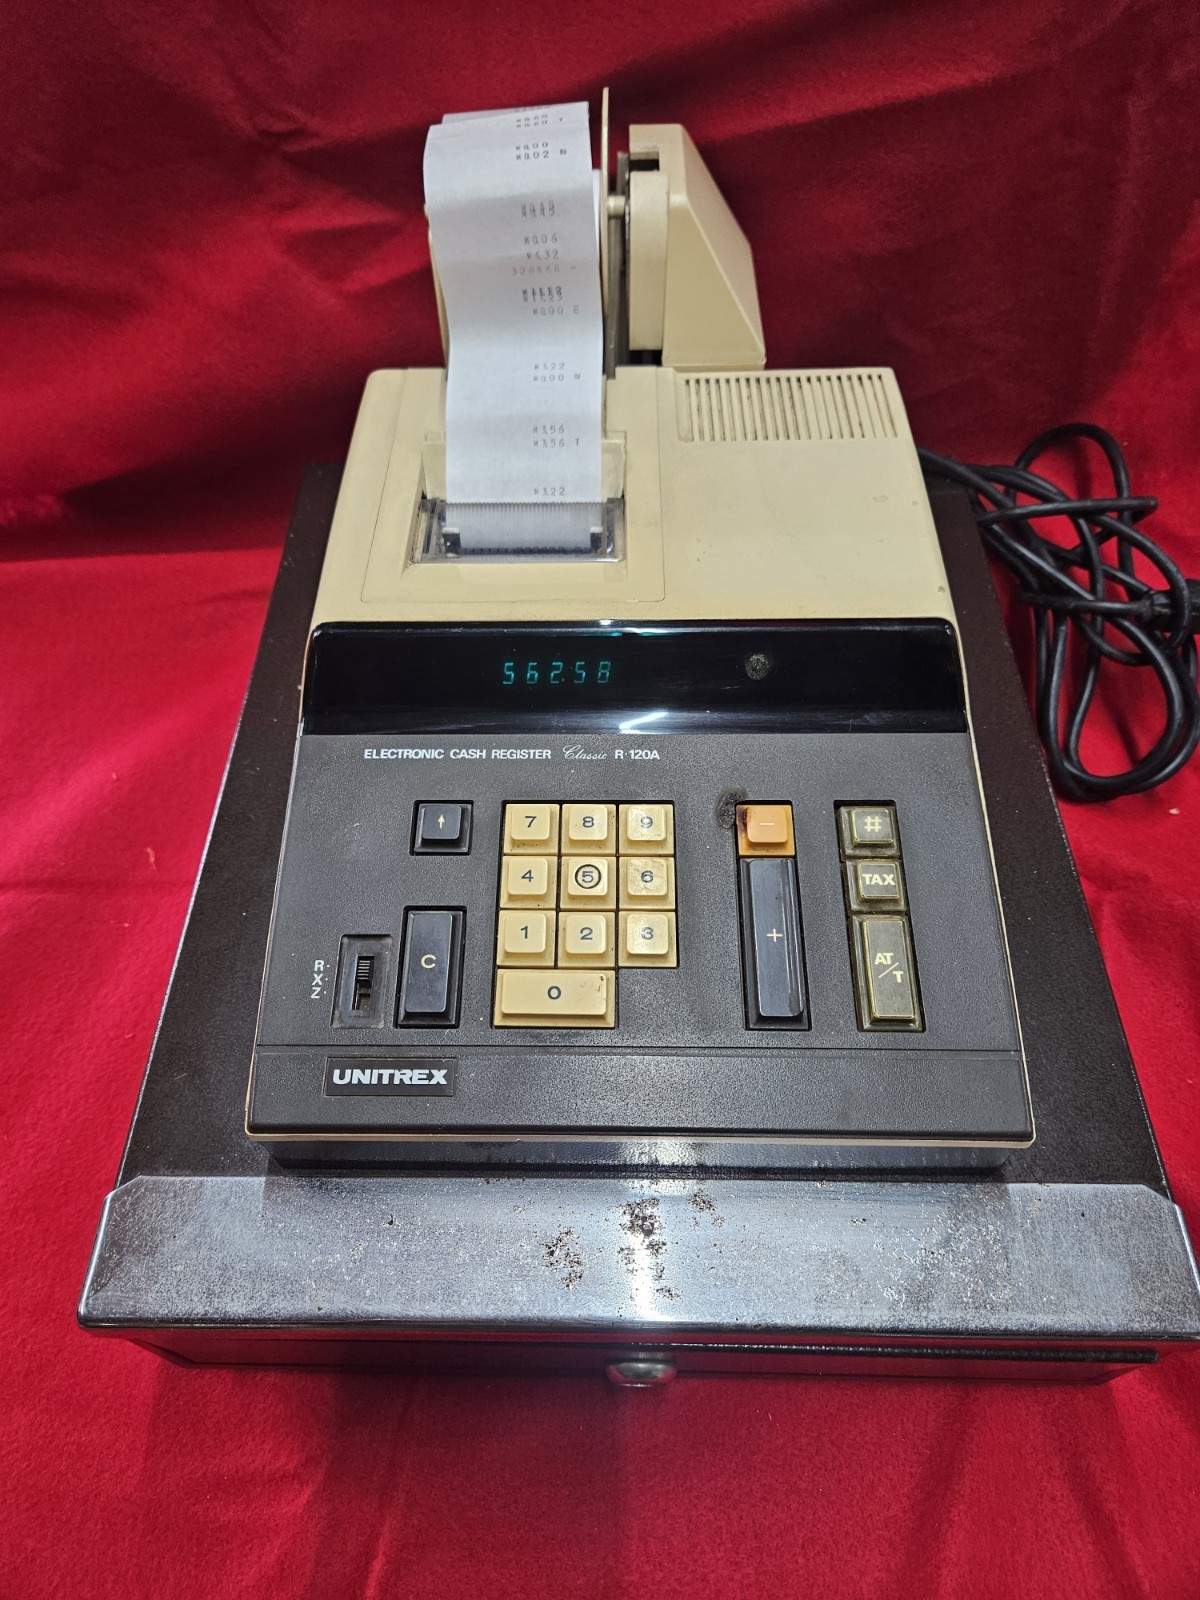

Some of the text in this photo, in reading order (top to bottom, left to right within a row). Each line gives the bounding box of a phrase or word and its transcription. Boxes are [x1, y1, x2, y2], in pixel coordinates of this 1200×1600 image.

[363, 748, 445, 760] ELECTRONIC
[449, 748, 487, 760] CASH
[491, 748, 552, 760] REGISTER
[562, 744, 608, 760] Classic
[525, 815, 537, 828] 7
[582, 815, 595, 828] 8
[640, 816, 654, 829] 9
[521, 869, 534, 882] 4
[582, 870, 594, 883] 5
[640, 870, 654, 883] 6
[862, 873, 896, 886] TAX
[520, 926, 529, 939] 1
[580, 927, 593, 940] 2
[641, 926, 654, 940] 3
[420, 953, 437, 969] C
[332, 1068, 448, 1085] UNITREX
